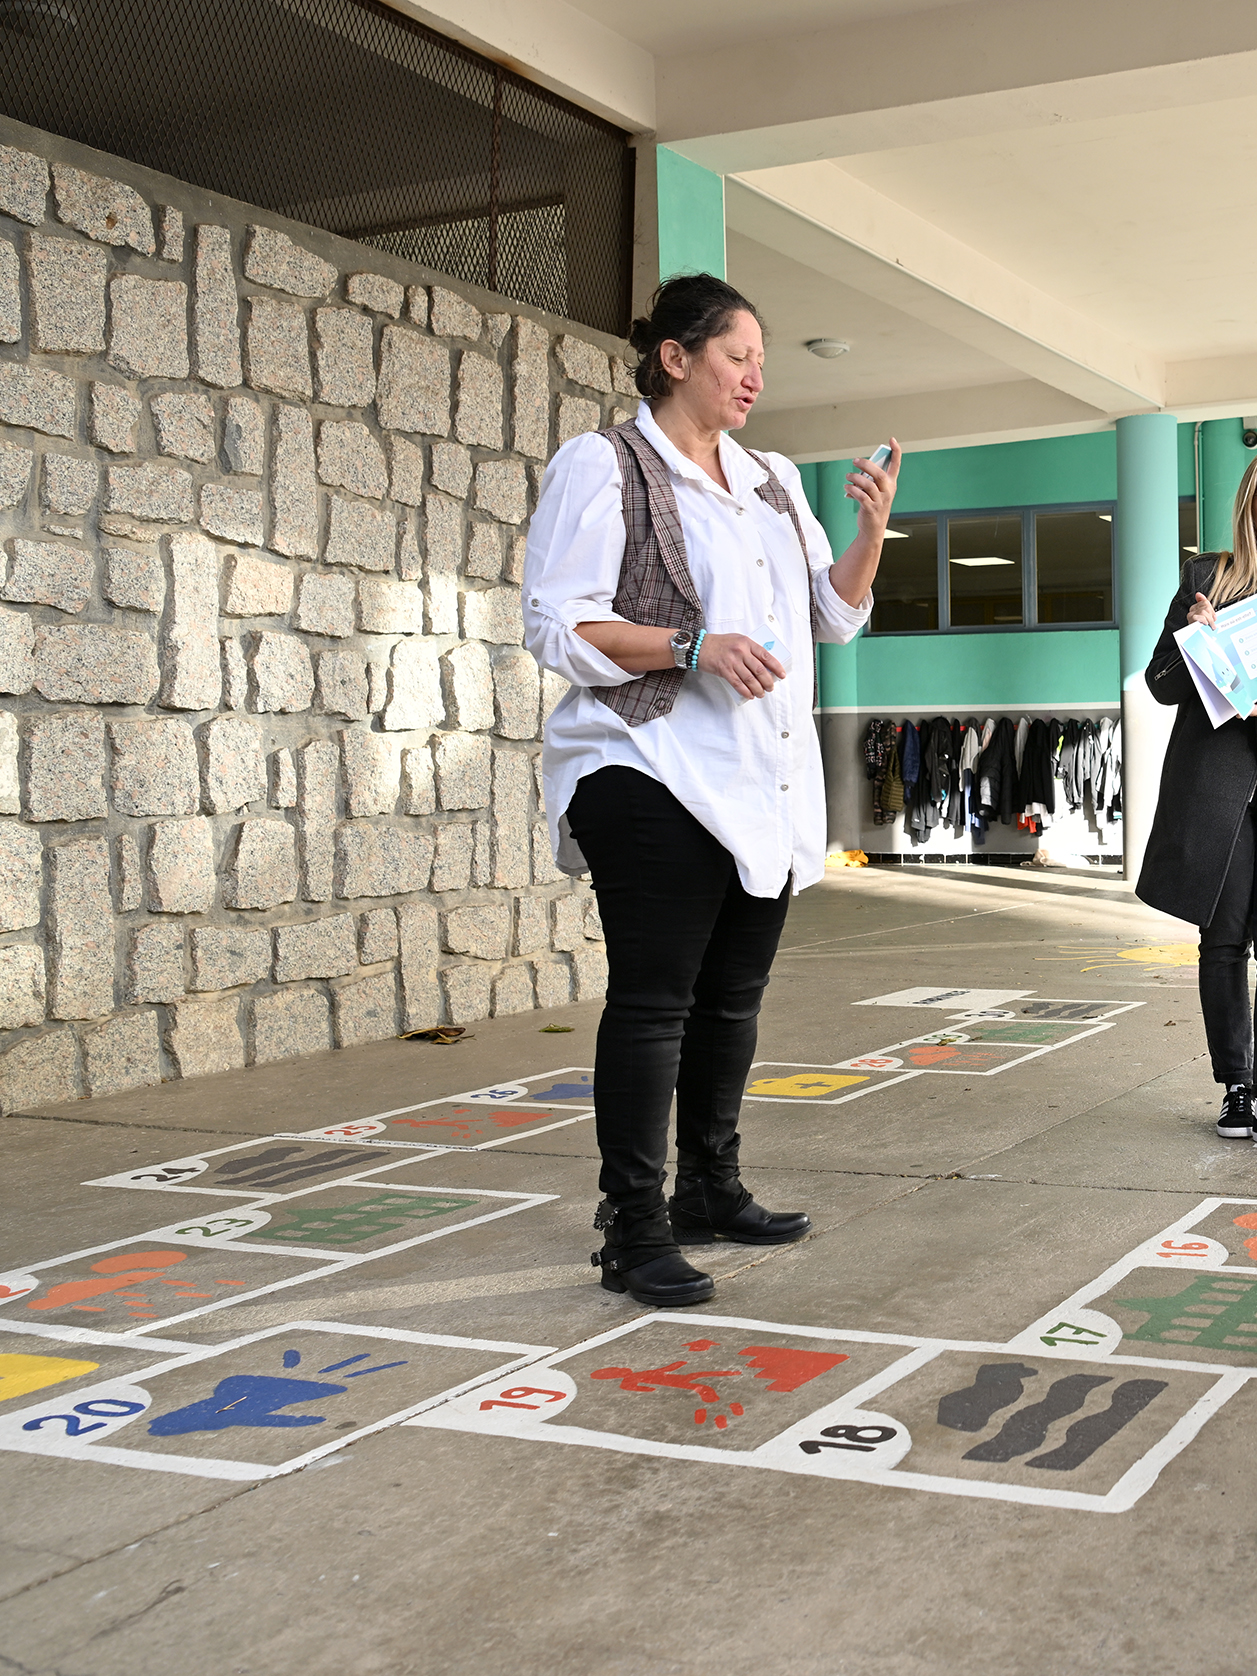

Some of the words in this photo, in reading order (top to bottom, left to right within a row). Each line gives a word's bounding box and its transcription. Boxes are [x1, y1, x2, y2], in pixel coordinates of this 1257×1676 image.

[850, 1058, 893, 1067] 28
[470, 1089, 518, 1099] 26
[324, 1124, 378, 1136] 25
[131, 1166, 201, 1183] 24
[175, 1218, 253, 1237] 23
[1156, 1239, 1209, 1258] 16
[1040, 1322, 1106, 1346] 17
[479, 1386, 567, 1410] 19
[22, 1398, 146, 1436] 20
[800, 1425, 897, 1454] 18
